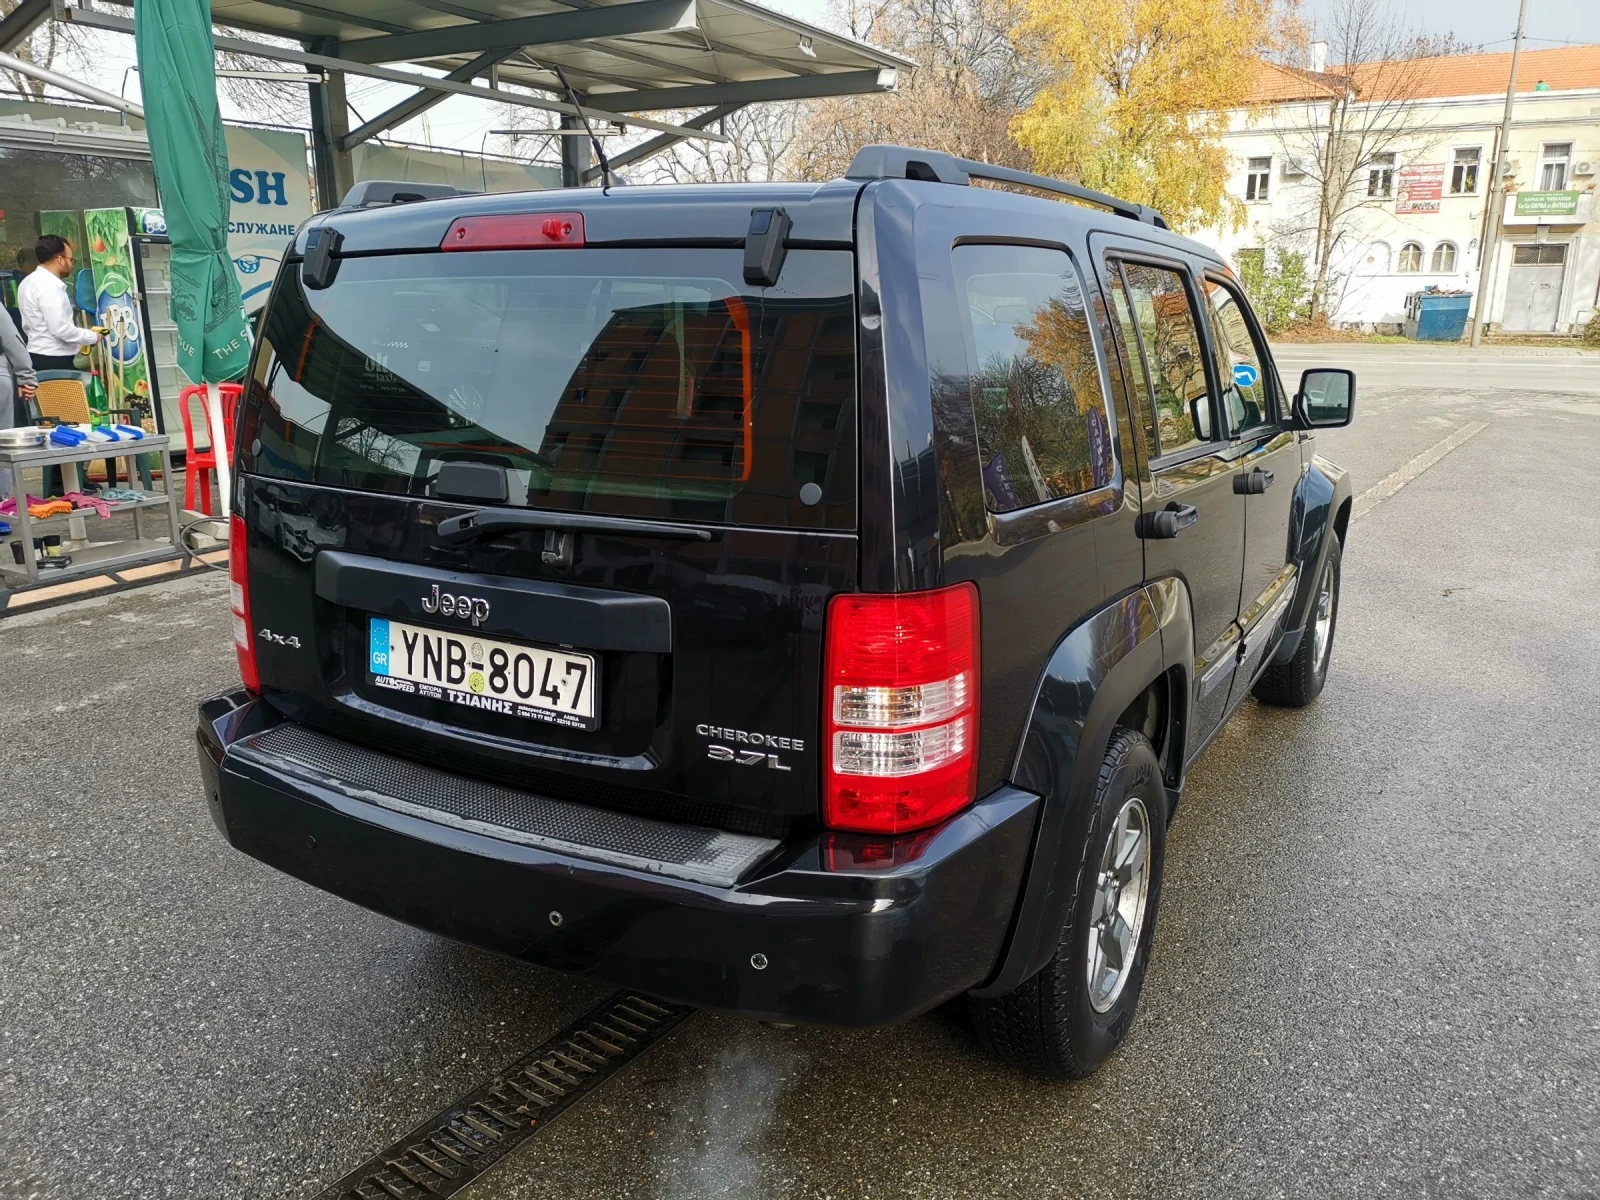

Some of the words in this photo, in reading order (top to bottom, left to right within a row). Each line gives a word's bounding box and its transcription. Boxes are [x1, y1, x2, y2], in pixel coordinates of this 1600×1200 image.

[230, 168, 288, 206] SH
[227, 221, 295, 236] СЛУЖАНЕ
[212, 338, 240, 360] THE
[421, 584, 490, 626] Jeep
[258, 628, 301, 648] 4x4
[373, 651, 388, 666] GR
[401, 629, 588, 710] YNB-8047
[447, 689, 513, 715] ΤΣΙΑΝΗΣ
[695, 723, 805, 751] CHEROKEE
[707, 744, 792, 771] 3.7L
